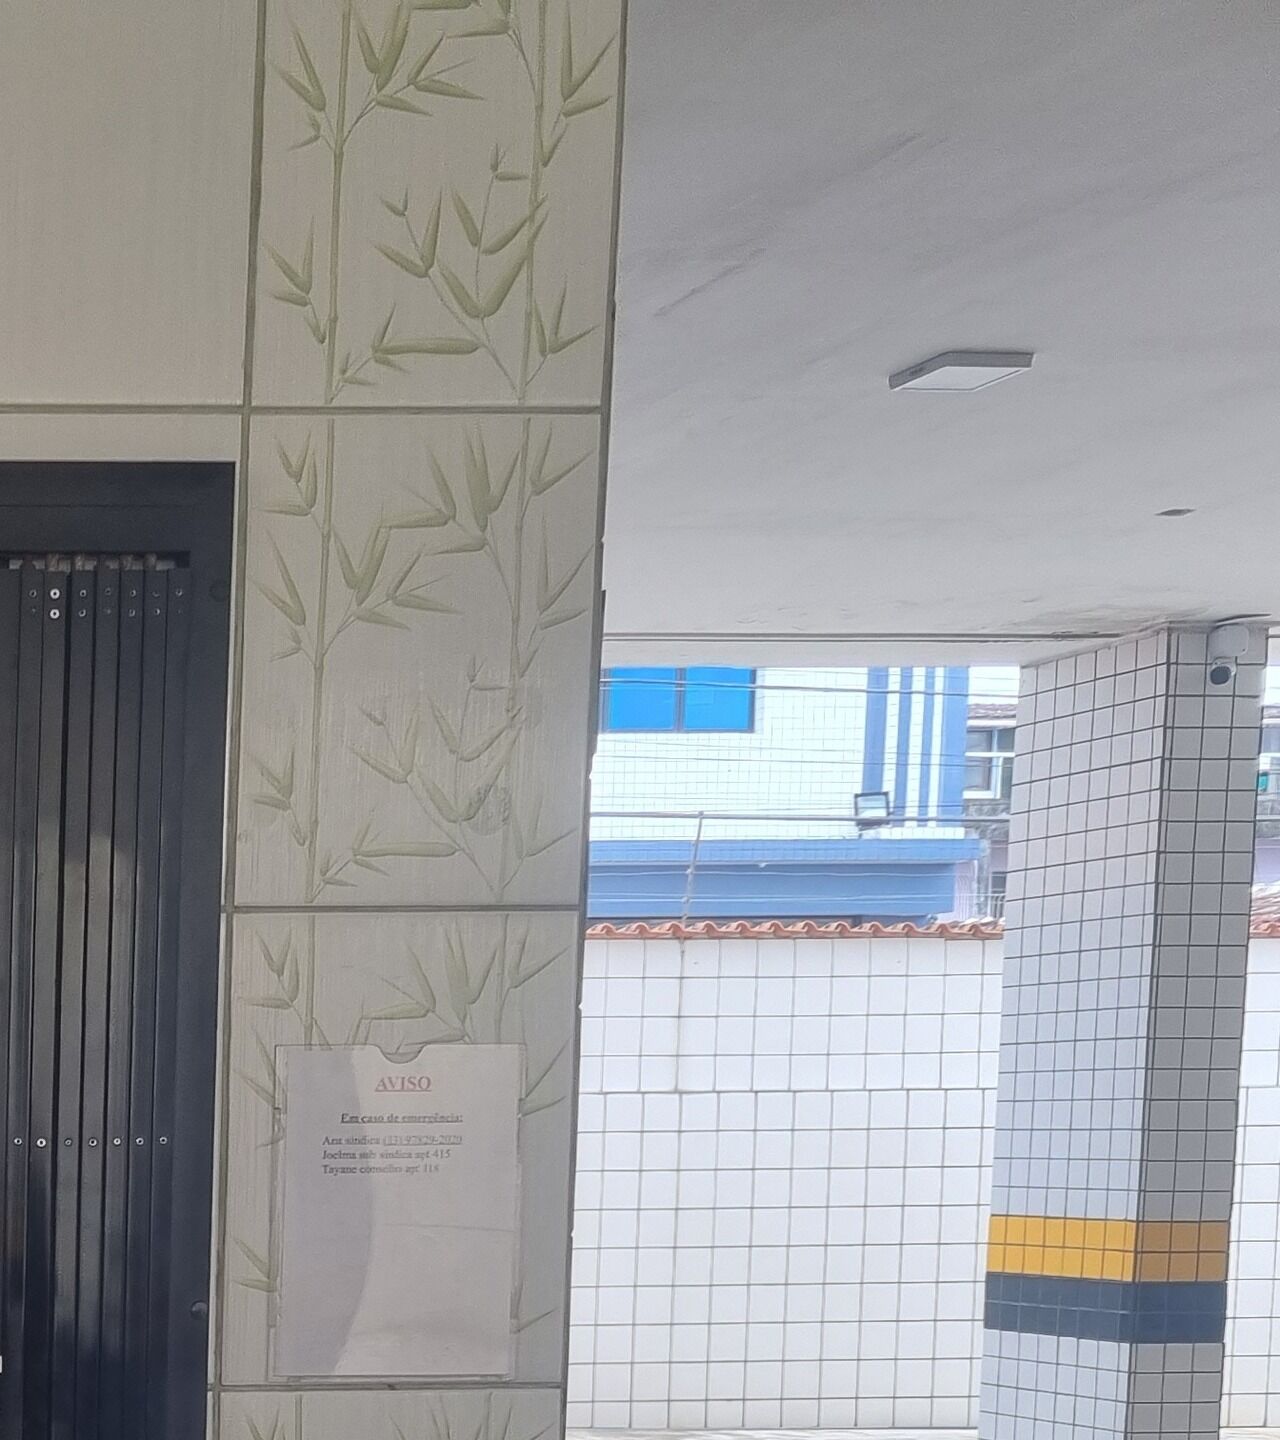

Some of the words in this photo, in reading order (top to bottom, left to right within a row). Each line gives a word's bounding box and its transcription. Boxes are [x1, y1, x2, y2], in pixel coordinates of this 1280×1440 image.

[375, 1076, 432, 1092] AVISO
[341, 1113, 359, 1123] Em
[361, 1114, 384, 1123] caso
[386, 1113, 399, 1123] de
[431, 1149, 450, 1159] 415
